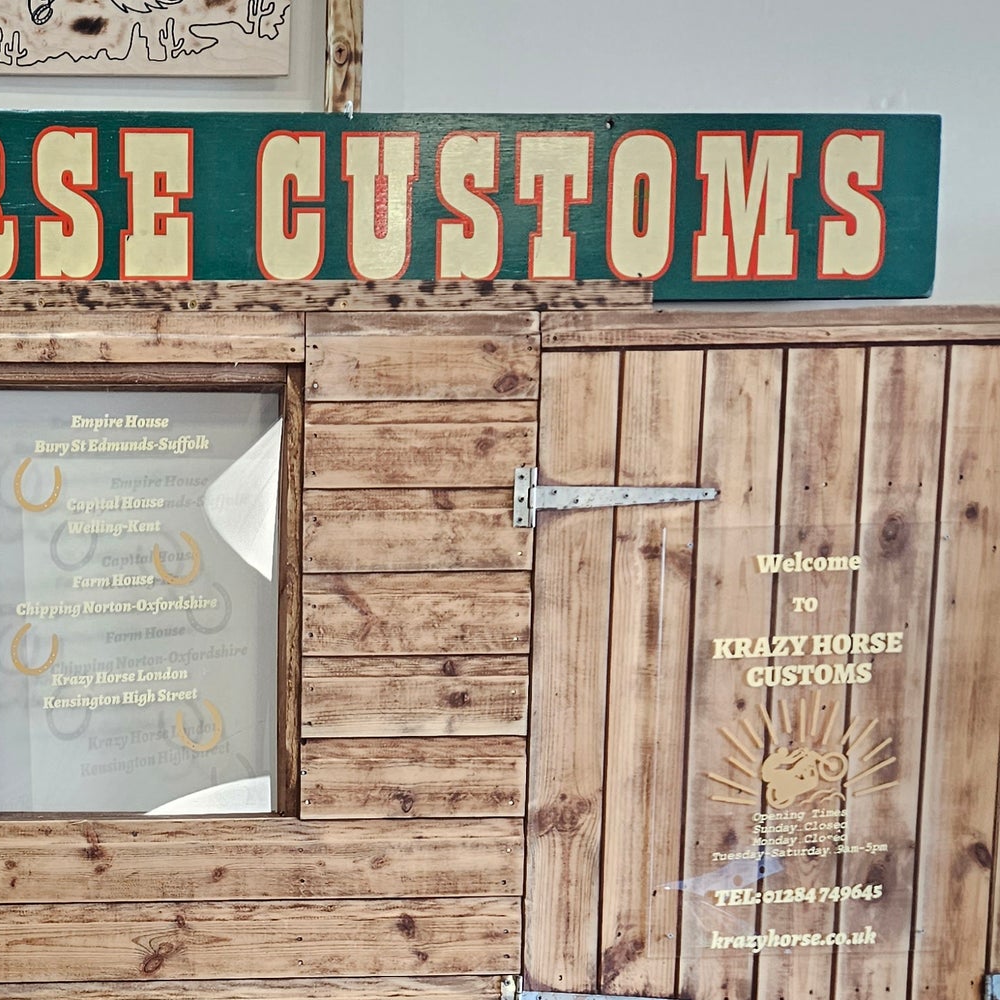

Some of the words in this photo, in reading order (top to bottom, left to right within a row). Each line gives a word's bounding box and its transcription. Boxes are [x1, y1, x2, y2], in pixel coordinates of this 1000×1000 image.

[257, 130, 885, 281] CUSTOMS
[71, 415, 123, 431] Empire
[124, 415, 169, 428] House
[34, 439, 70, 456] Bury
[71, 438, 87, 452] St
[88, 435, 209, 454] Edmunds-Suffolk
[66, 497, 121, 513] Capital
[121, 496, 165, 509] House
[67, 519, 161, 537] Welling-Kent
[756, 551, 862, 573] Welcome
[72, 575, 110, 588] Farm
[111, 573, 154, 587] House
[16, 602, 80, 619] Chipping
[83, 595, 217, 615] Norton-Oxfordshire
[792, 597, 818, 612] TO
[712, 635, 808, 659] KRAZY
[811, 632, 903, 655] HORSE
[52, 673, 94, 688] Krazy
[95, 670, 135, 684] Horse
[137, 667, 188, 682] London
[746, 663, 873, 687] CUSTOMS
[43, 695, 121, 711] Kensington
[122, 691, 156, 706] High
[158, 688, 198, 702] Street
[752, 811, 805, 822] Opening
[812, 808, 848, 819] Times
[752, 823, 797, 835] Sunday
[804, 820, 848, 831] Closed
[752, 836, 797, 847] Monday
[804, 832, 848, 844] Closed
[835, 843, 889, 855] 9am-5pm
[818, 884, 883, 903] 749645
[711, 926, 877, 953] krazyhorse.co.uk
